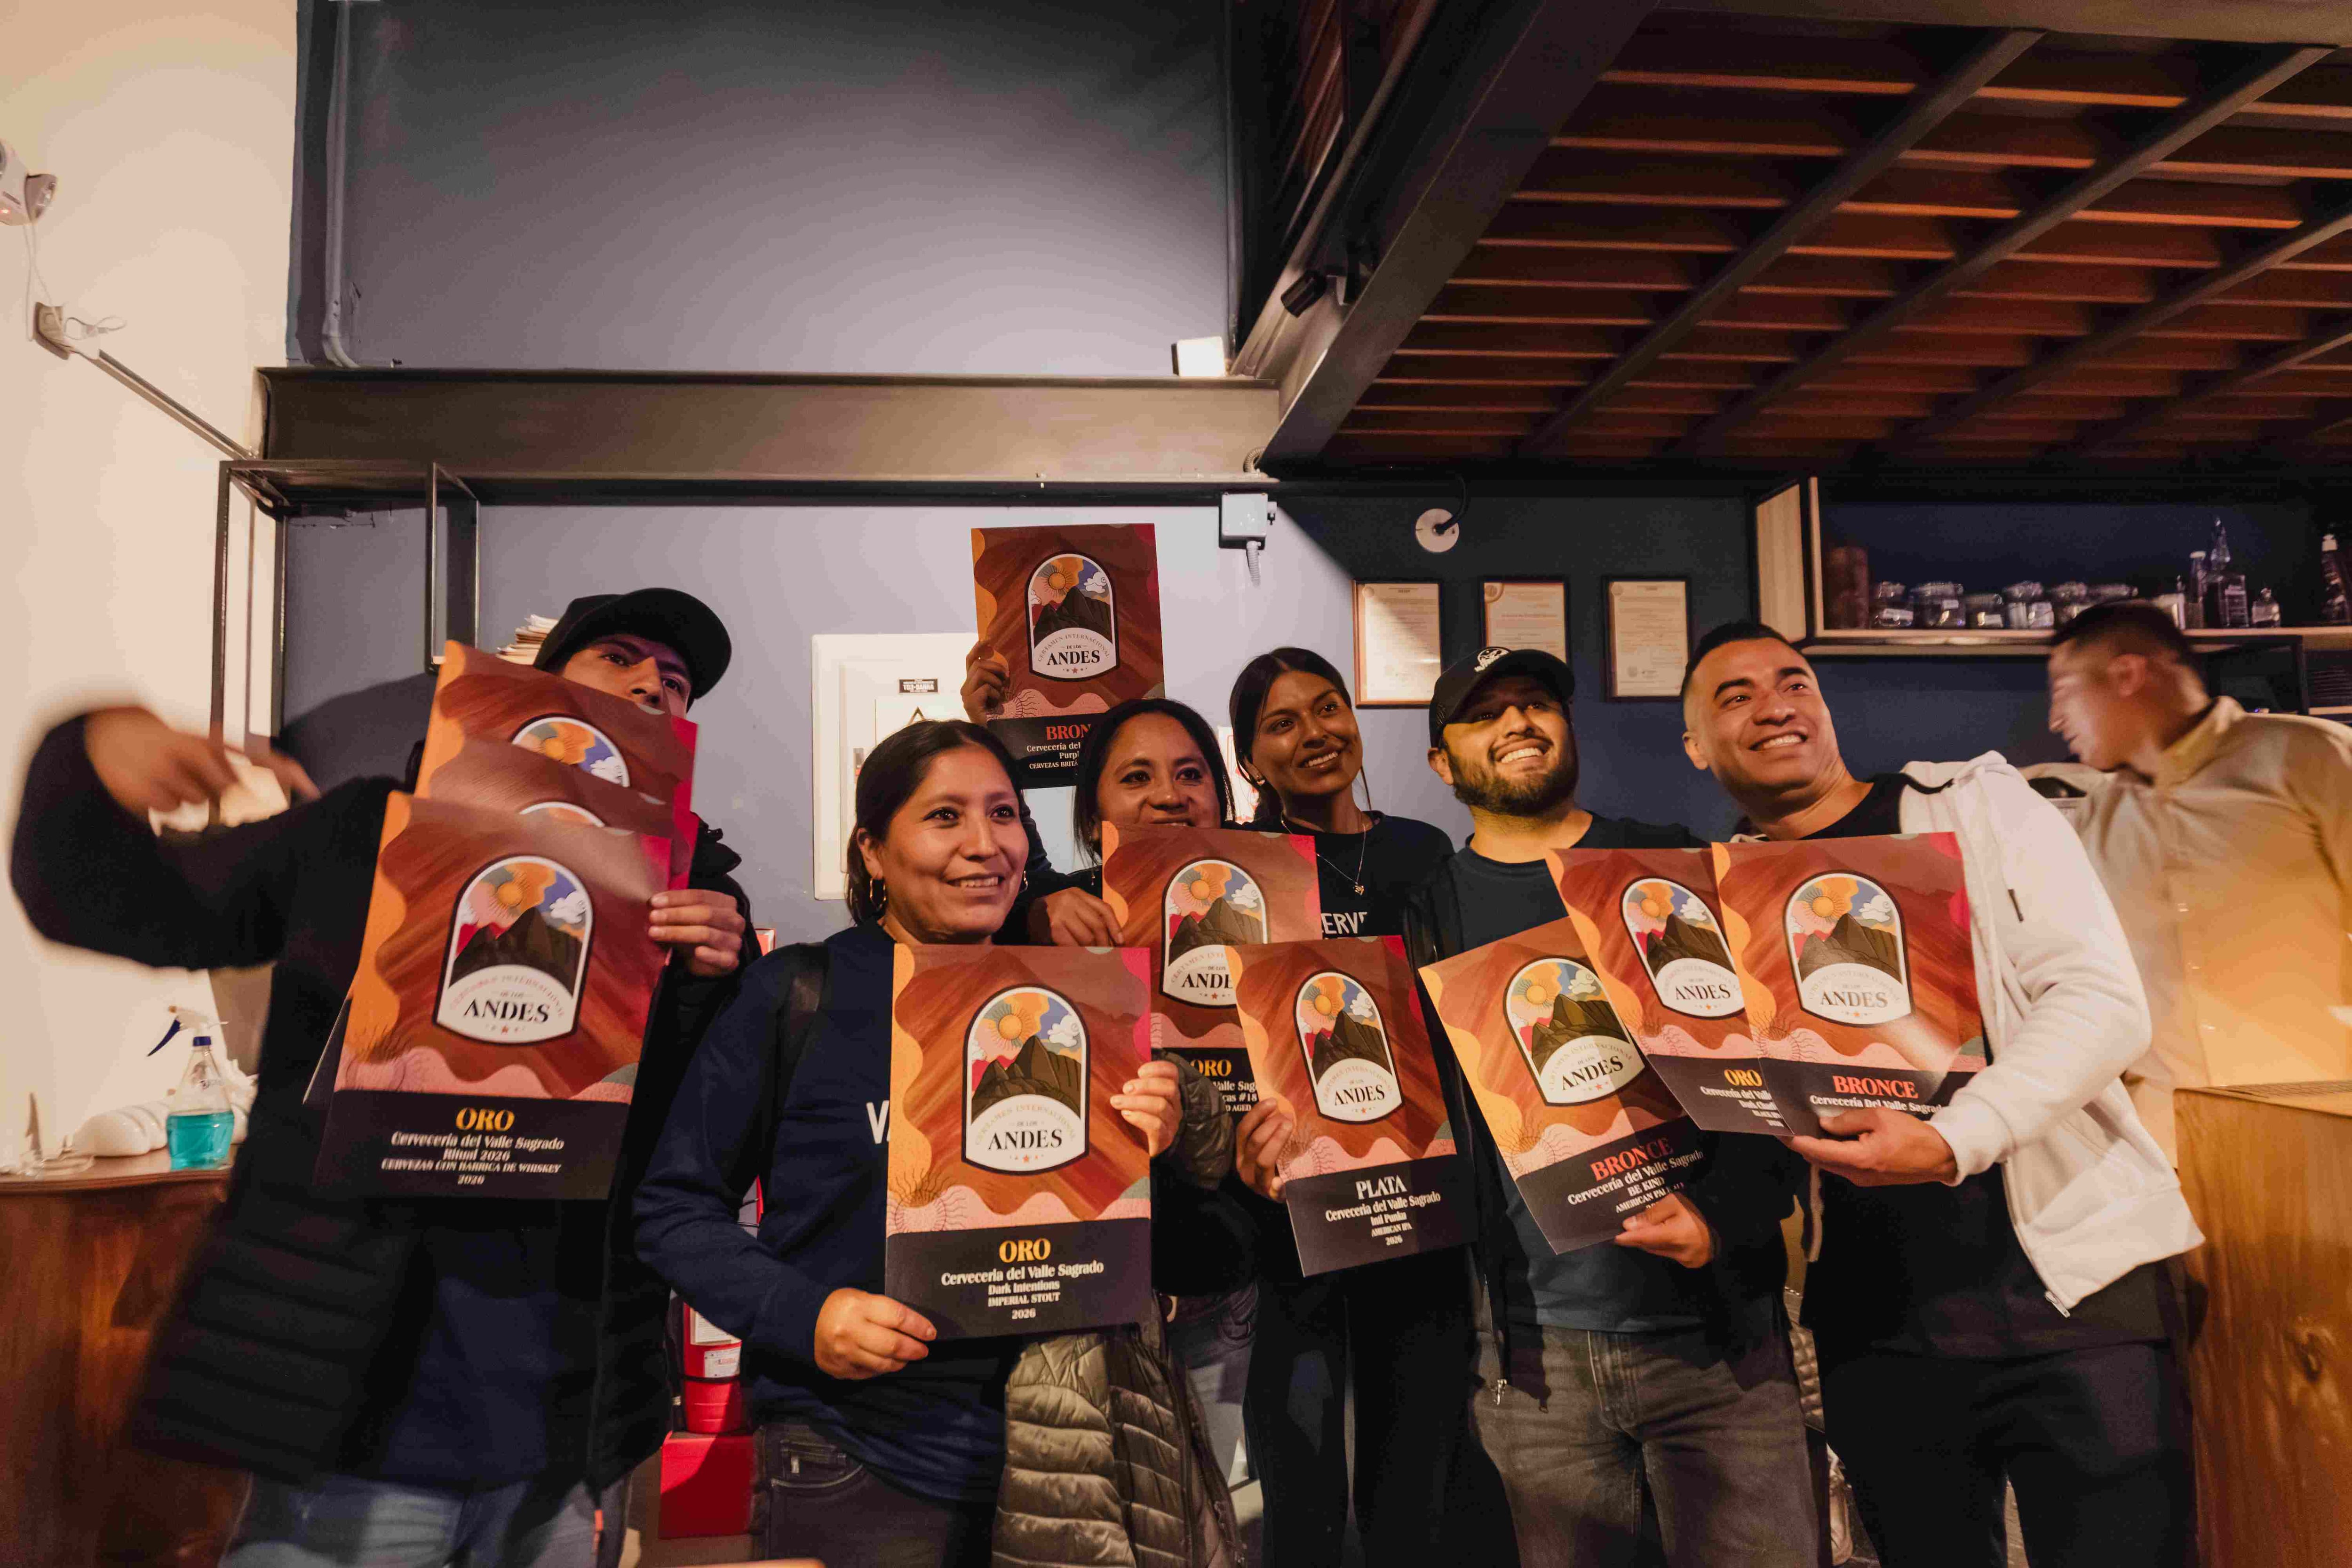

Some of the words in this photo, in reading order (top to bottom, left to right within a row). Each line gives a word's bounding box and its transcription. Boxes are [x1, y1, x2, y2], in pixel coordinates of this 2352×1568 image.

[1038, 637, 1064, 661] CERTAMEN
[1065, 633, 1110, 659] INTERNACIONAL
[1047, 650, 1100, 665] ANDES
[1026, 742, 1067, 752] Cervecería
[1320, 912, 1367, 934] ERV
[1676, 984, 1731, 1000] ANDES
[1820, 990, 1888, 1008] ANDES
[463, 998, 550, 1023] ANDES
[1190, 1059, 1232, 1077] ORO
[1562, 1055, 1623, 1090] ANDES
[1724, 1069, 1763, 1087] ORO
[1335, 1084, 1385, 1106] ANDES
[1833, 1075, 1918, 1099] BRONCE
[1810, 1095, 1864, 1107] Cervecería
[455, 1107, 516, 1131] ORO
[866, 1099, 891, 1144] V
[460, 1134, 482, 1148] del
[483, 1135, 513, 1149] Valle
[515, 1137, 565, 1152] Sagrado
[988, 1129, 1063, 1151] ANDES
[502, 1163, 516, 1172] DE
[518, 1163, 562, 1174] WHISKEY
[1589, 1137, 1675, 1181] BRONCE
[1355, 1175, 1408, 1200] PLATA
[1567, 1177, 1624, 1205] Cervecería
[1624, 1169, 1644, 1184] del
[1642, 1162, 1669, 1177] Valle
[1627, 1182, 1642, 1197] BE
[1644, 1177, 1665, 1192] KIND
[1372, 1200, 1387, 1213] del
[1387, 1196, 1408, 1210] Valle
[1408, 1191, 1441, 1208] Sagrado
[1615, 1193, 1654, 1213] AMERICAN
[999, 1238, 1051, 1263] ORO
[1006, 1266, 1025, 1281] del
[1027, 1264, 1056, 1279] Valle
[1058, 1259, 1104, 1279] Sagrado
[988, 1283, 1012, 1295] Dark
[1013, 1280, 1060, 1293] Intentions
[1031, 1292, 1061, 1303] STOUT
